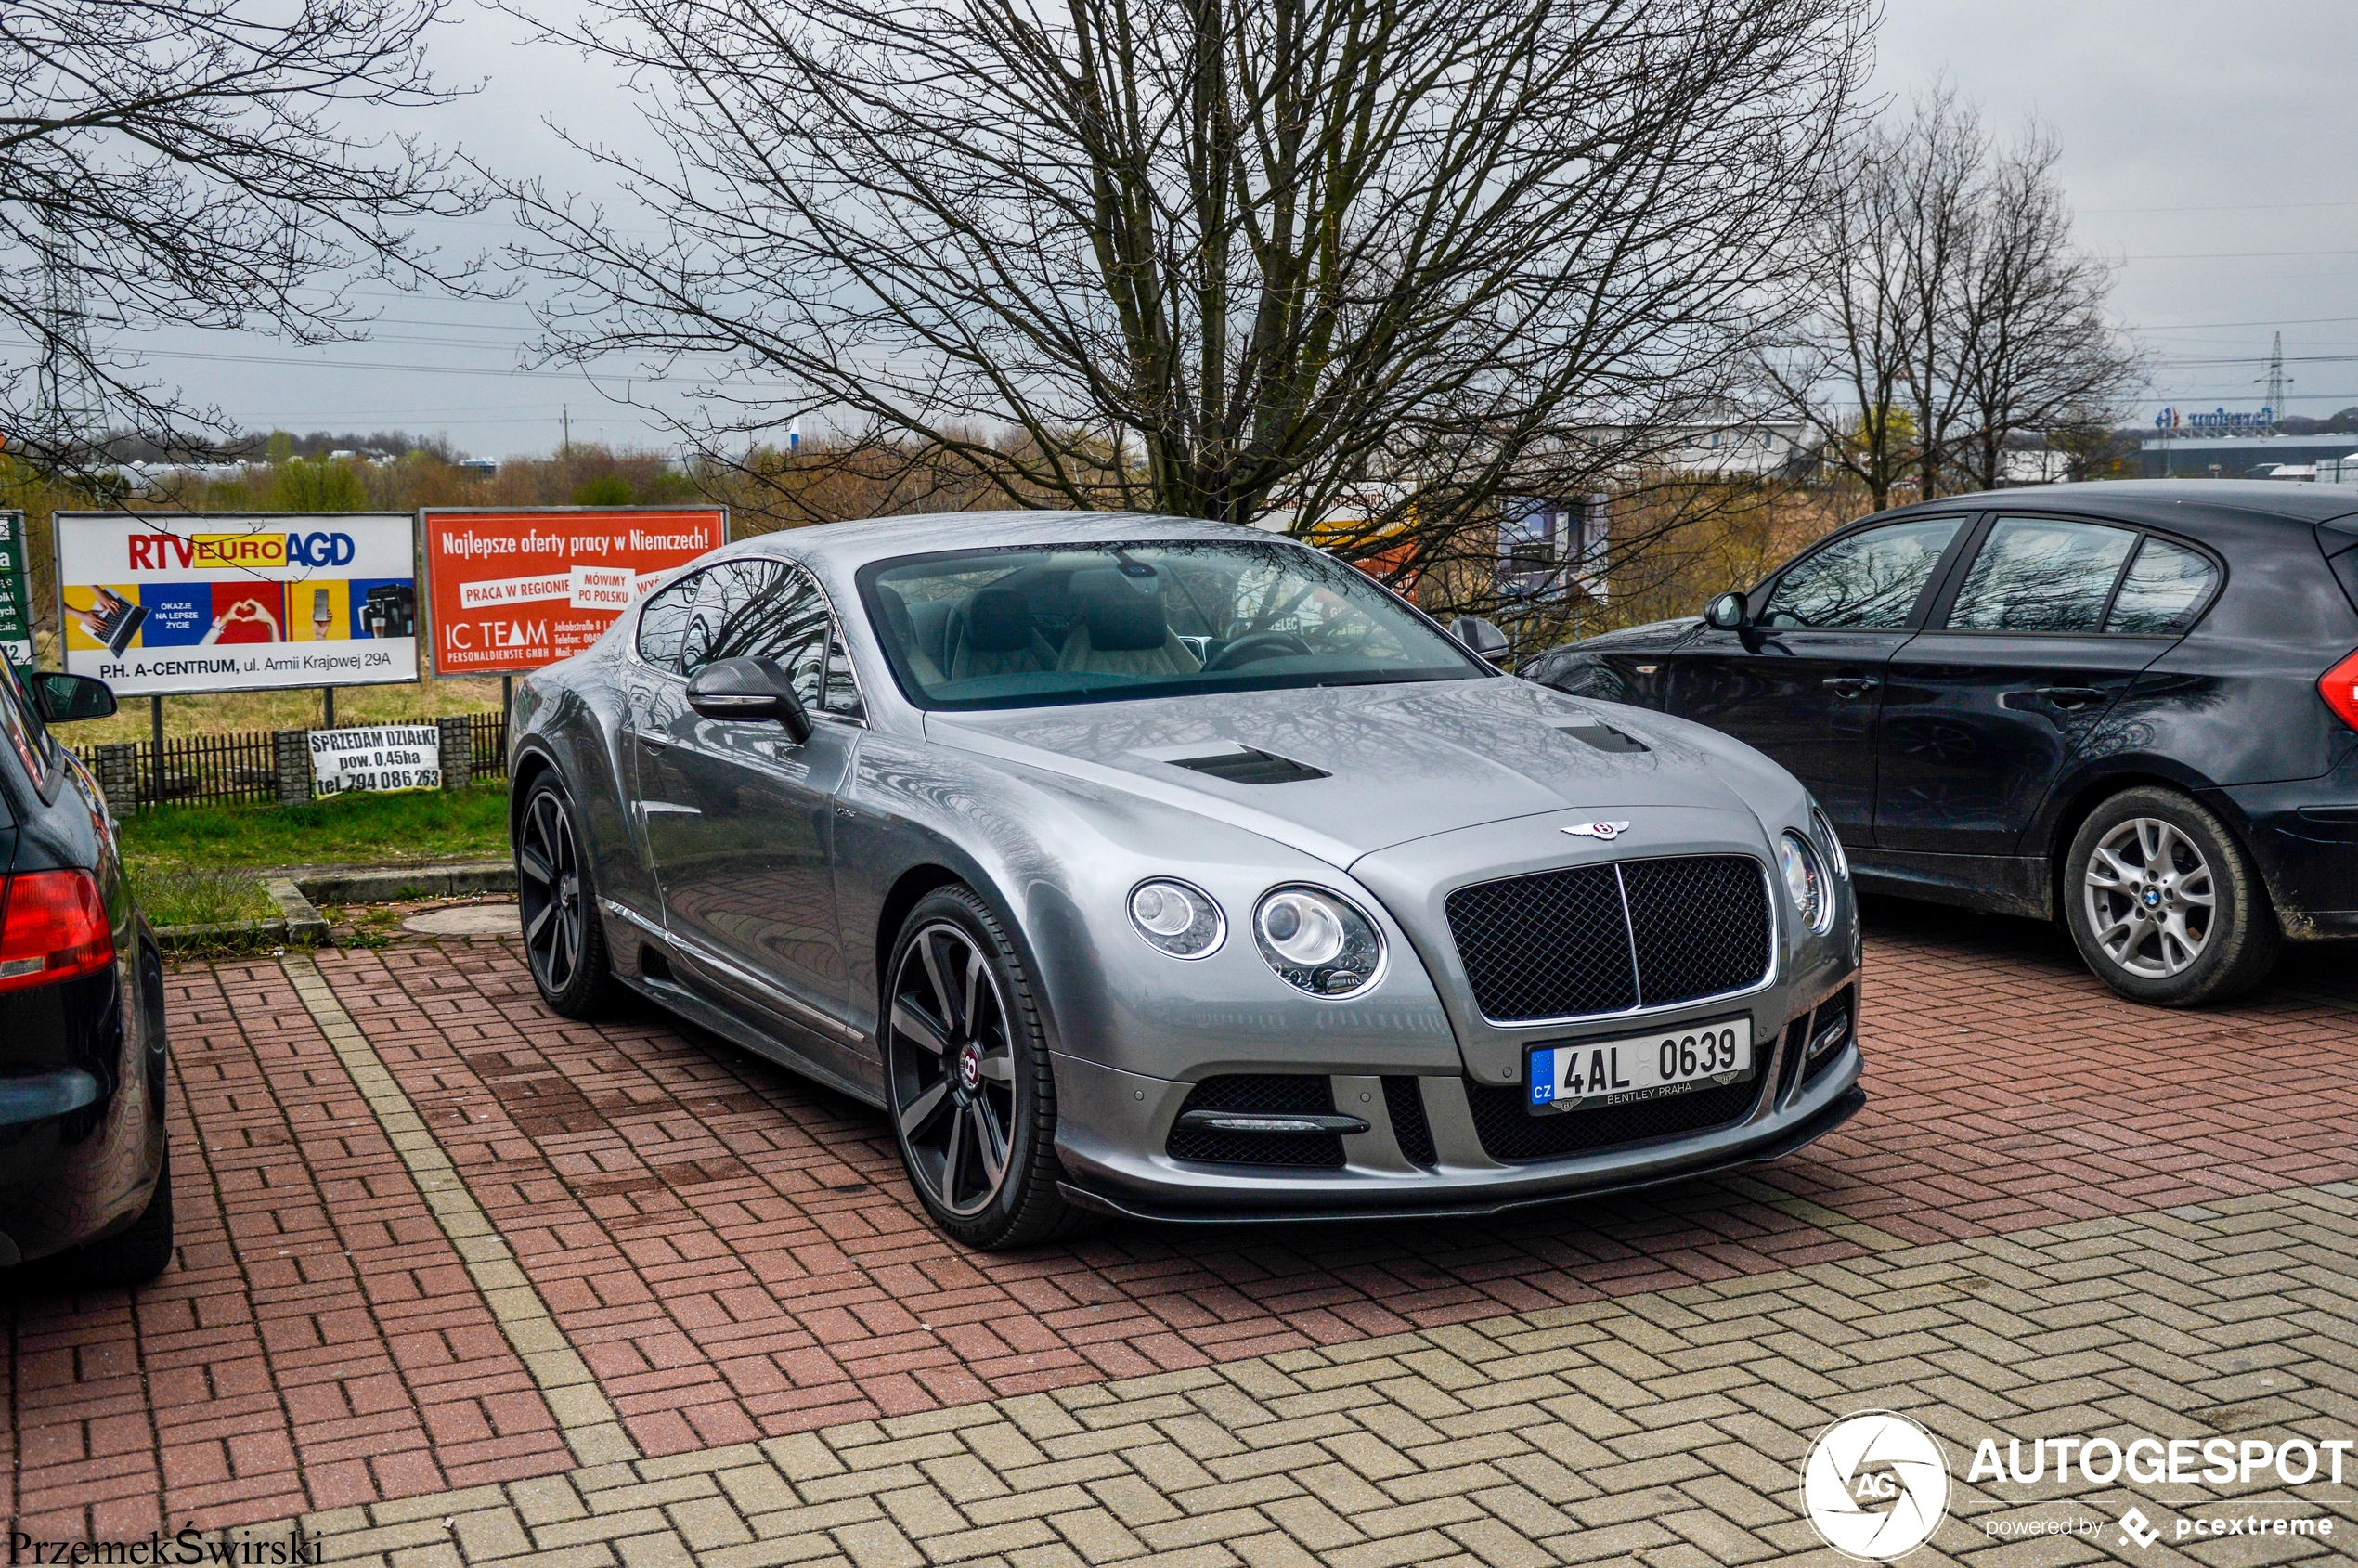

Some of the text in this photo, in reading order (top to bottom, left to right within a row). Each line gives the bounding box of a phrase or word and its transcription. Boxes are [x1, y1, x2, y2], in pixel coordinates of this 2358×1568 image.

[128, 532, 356, 569] RTV EURO AGD
[442, 526, 709, 560] Najlepsze oferty pracy w Niemczech!
[465, 579, 570, 602] PRACA W REGIONIE
[584, 573, 627, 587] MÓWIMY
[578, 590, 628, 603] PO POLSKU
[165, 620, 190, 629] ŻYCIE
[446, 620, 548, 649] IC TEAM
[554, 620, 594, 631] Jakobstraße
[595, 620, 601, 630] 8
[554, 634, 581, 644] Telefon:
[100, 652, 391, 679] P.H. A-CENTRUM, ul. Armii Krajowej 29A
[447, 648, 549, 663] PERSONALDIENSTE GMBH
[311, 732, 384, 753] SPRZEDAM
[339, 750, 421, 771] pow. 0,45ha
[317, 770, 439, 795] tel. 794 086 263
[1535, 1028, 1736, 1099] CZ 4AL 0639
[1607, 1082, 1691, 1105] BENTLEY PRAHA
